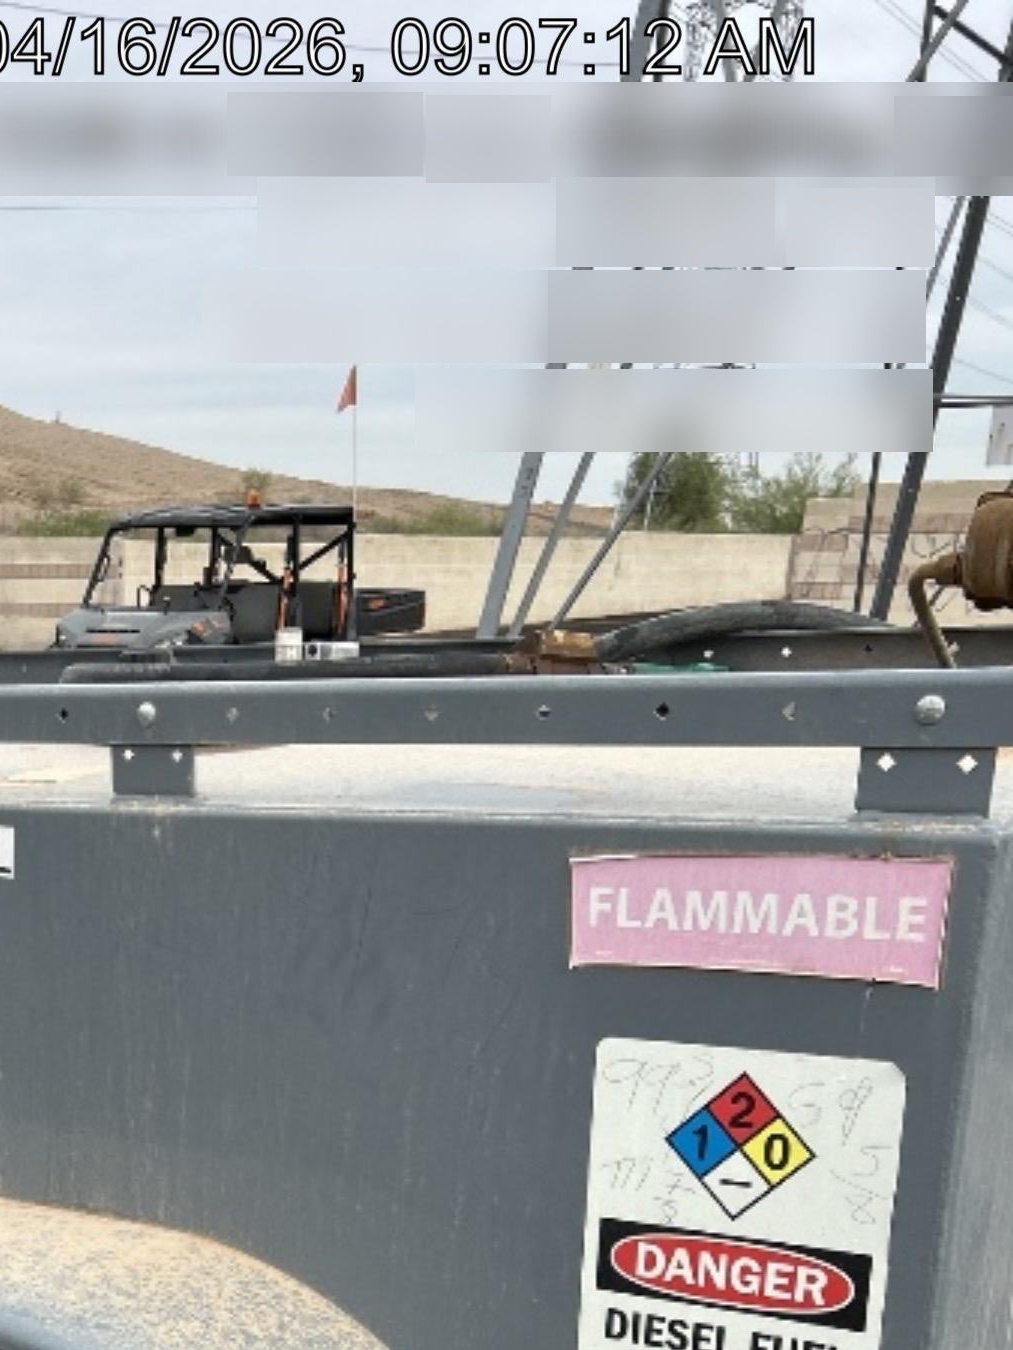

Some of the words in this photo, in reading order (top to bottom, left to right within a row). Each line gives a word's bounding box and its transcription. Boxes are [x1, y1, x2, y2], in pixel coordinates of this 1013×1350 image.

[588, 886, 928, 943] FLAMMABLE
[728, 1091, 755, 1129] 2
[692, 1124, 709, 1161] 1
[763, 1134, 790, 1171] 0
[635, 1241, 829, 1306] DANGER
